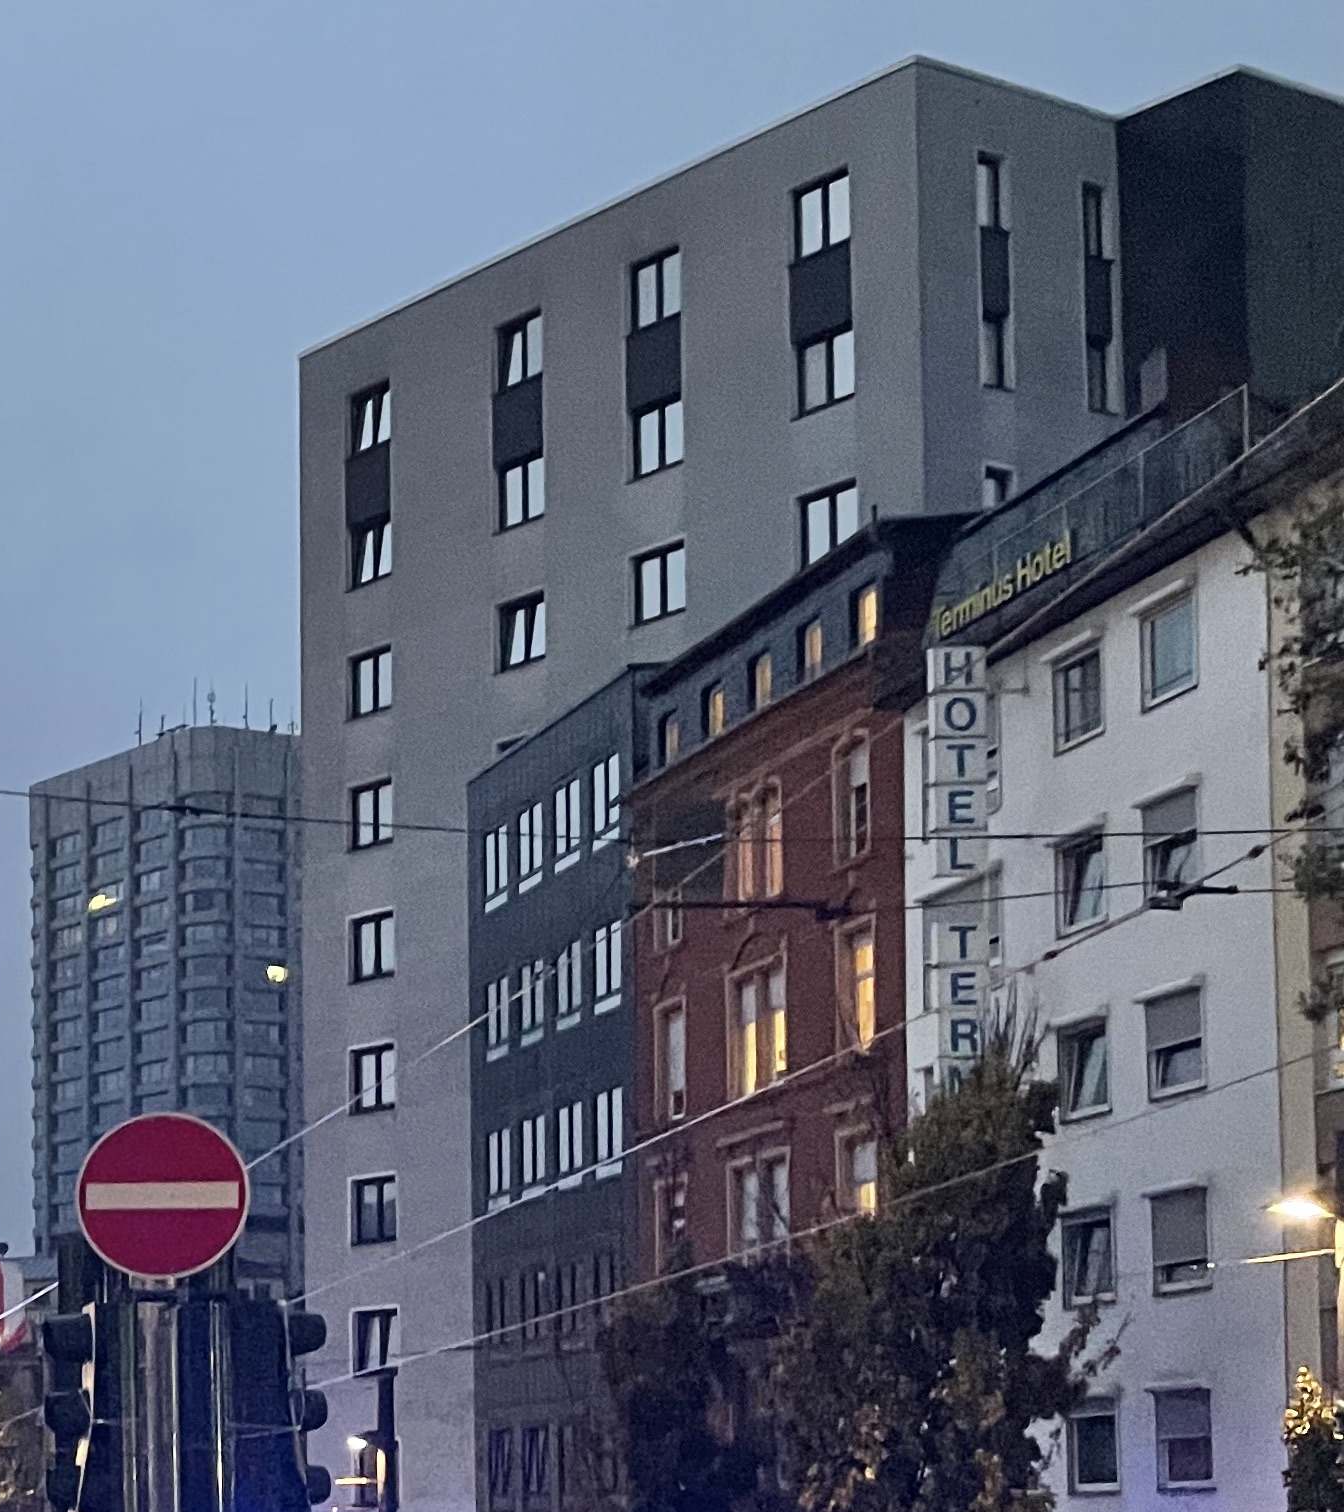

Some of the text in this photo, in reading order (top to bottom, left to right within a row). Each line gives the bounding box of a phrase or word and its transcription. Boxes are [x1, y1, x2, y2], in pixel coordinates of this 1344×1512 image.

[929, 528, 1073, 641] Terminus Hotel
[943, 651, 977, 870] HOTEL
